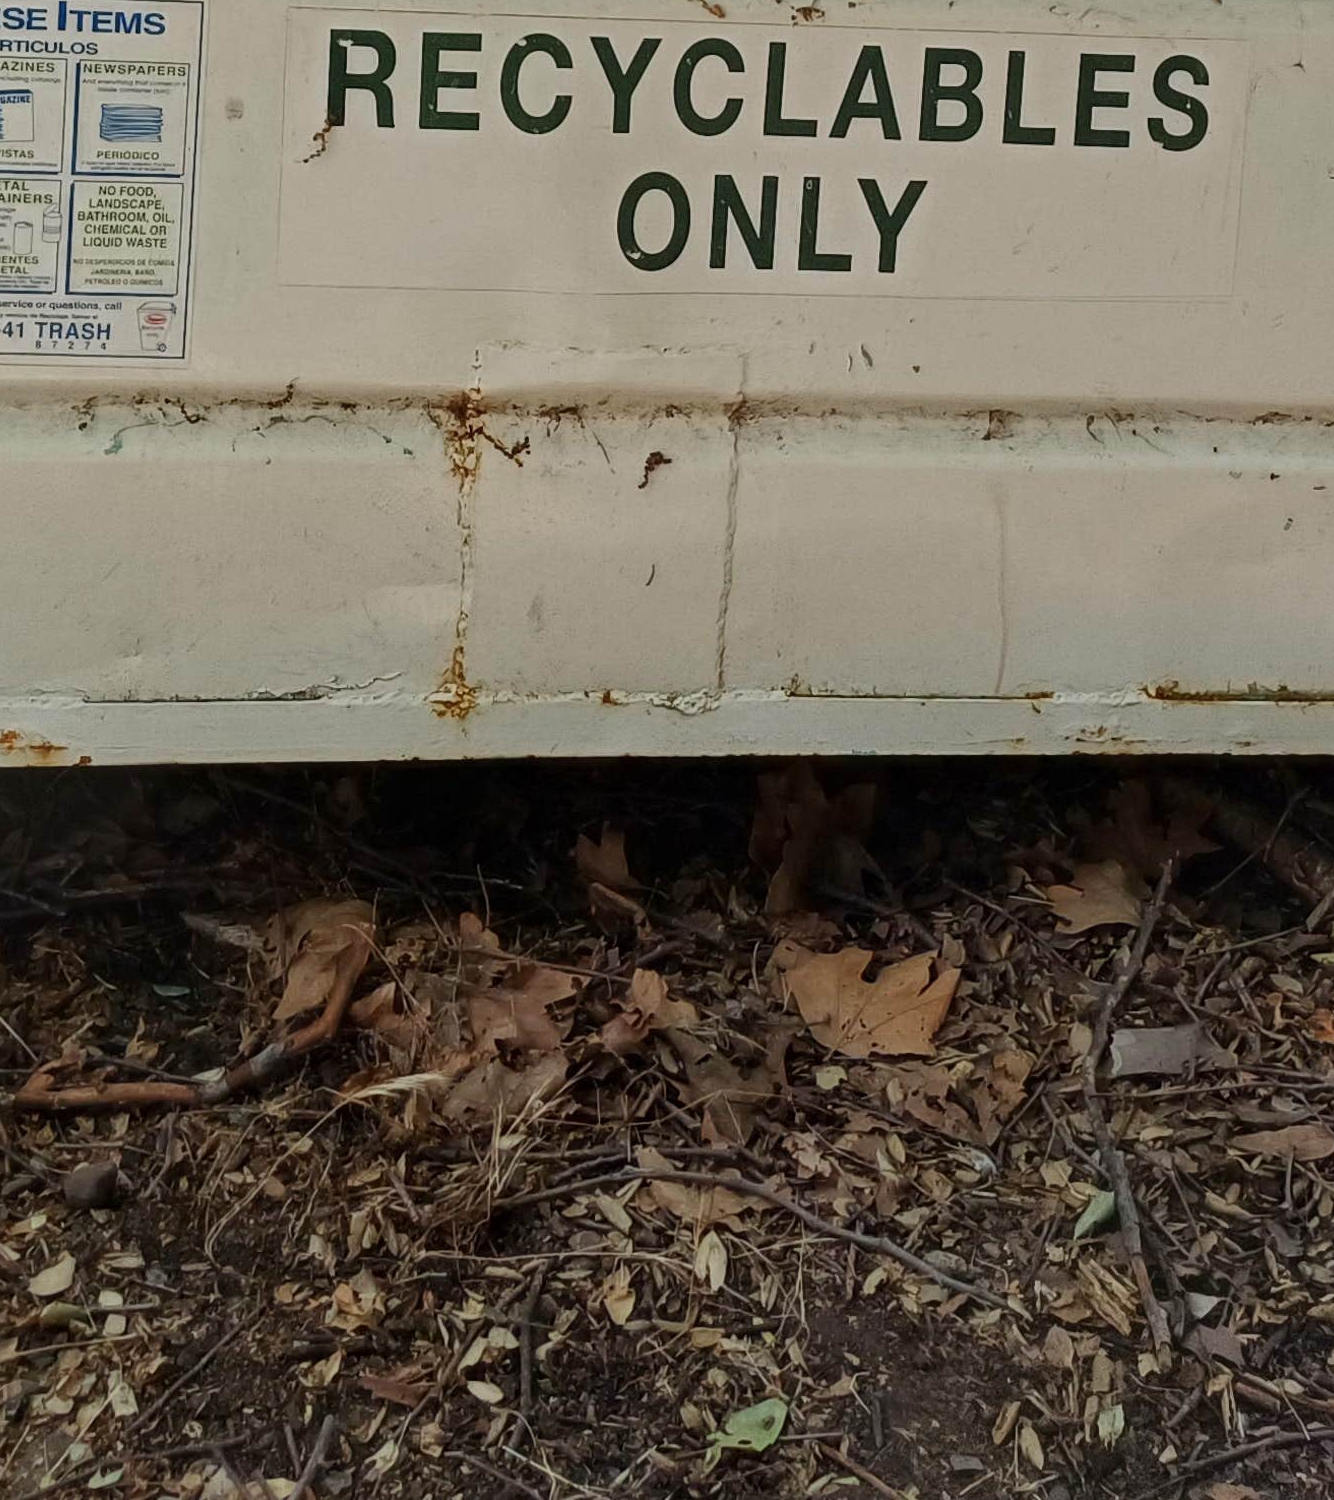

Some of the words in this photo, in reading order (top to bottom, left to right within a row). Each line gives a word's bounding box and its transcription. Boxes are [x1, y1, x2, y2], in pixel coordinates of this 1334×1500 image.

[58, 1, 165, 35] ITEMS
[83, 64, 186, 77] NEWSPAPERS
[328, 29, 1211, 152] RECYCLABLES
[99, 186, 116, 196] NO
[119, 187, 157, 198] FOOD,
[89, 199, 164, 210] LANDSCAPE,
[78, 211, 149, 223] BATHROOM,
[153, 212, 174, 223] OIL,
[616, 171, 929, 274] ONLY
[85, 225, 146, 235] CHEMICAL
[150, 225, 166, 235] OR
[83, 237, 122, 247] LIQUID
[126, 238, 167, 248] WASTE
[50, 302, 102, 311] questions,
[104, 302, 122, 310] call
[35, 322, 111, 340] TRASH
